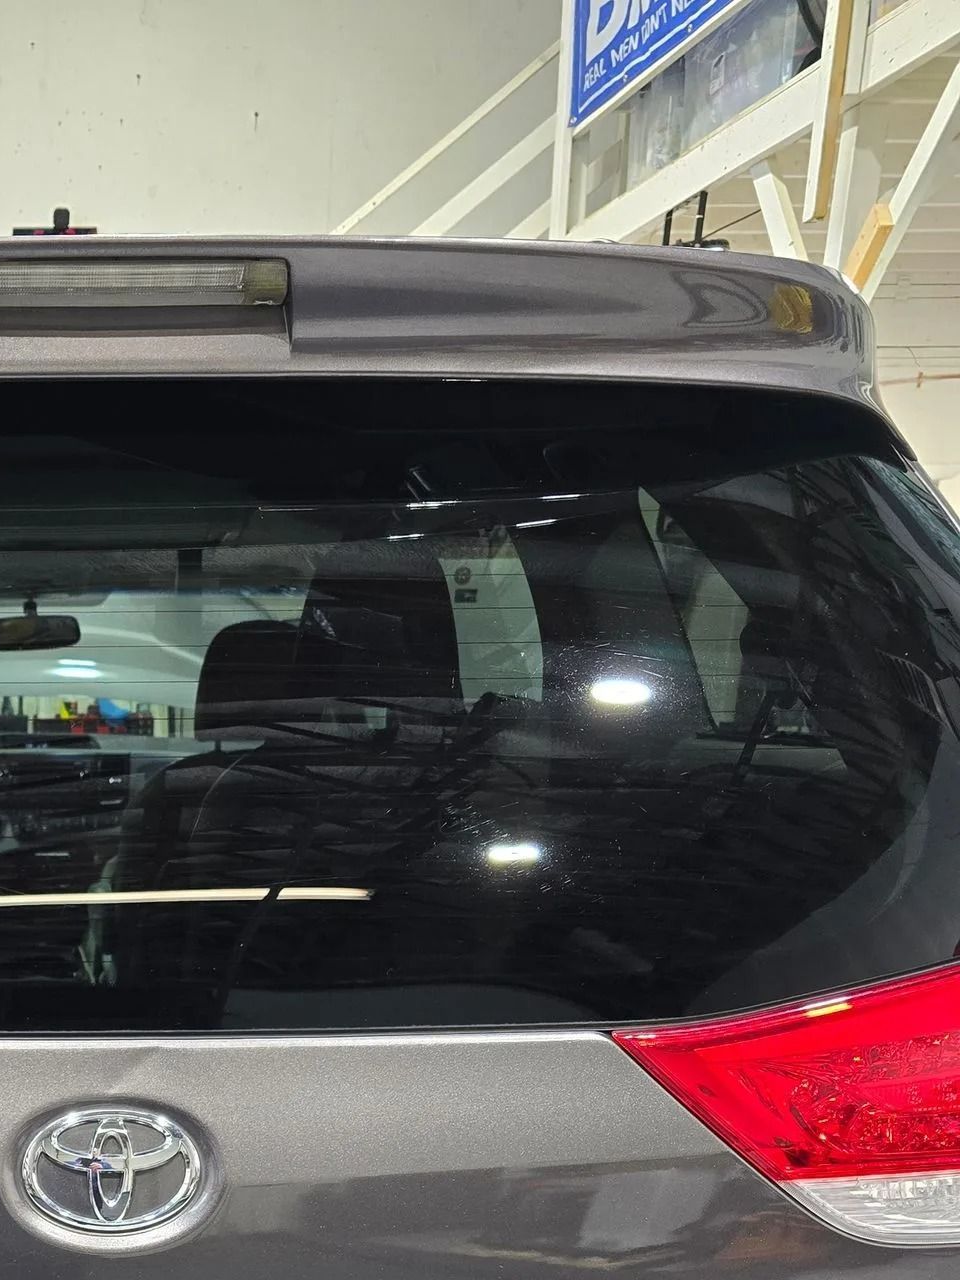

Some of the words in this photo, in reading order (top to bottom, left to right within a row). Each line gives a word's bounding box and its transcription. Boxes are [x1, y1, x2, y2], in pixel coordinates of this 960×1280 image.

[583, 58, 607, 91] REAL
[611, 32, 639, 67] MEN
[641, 2, 667, 44] DON'T
